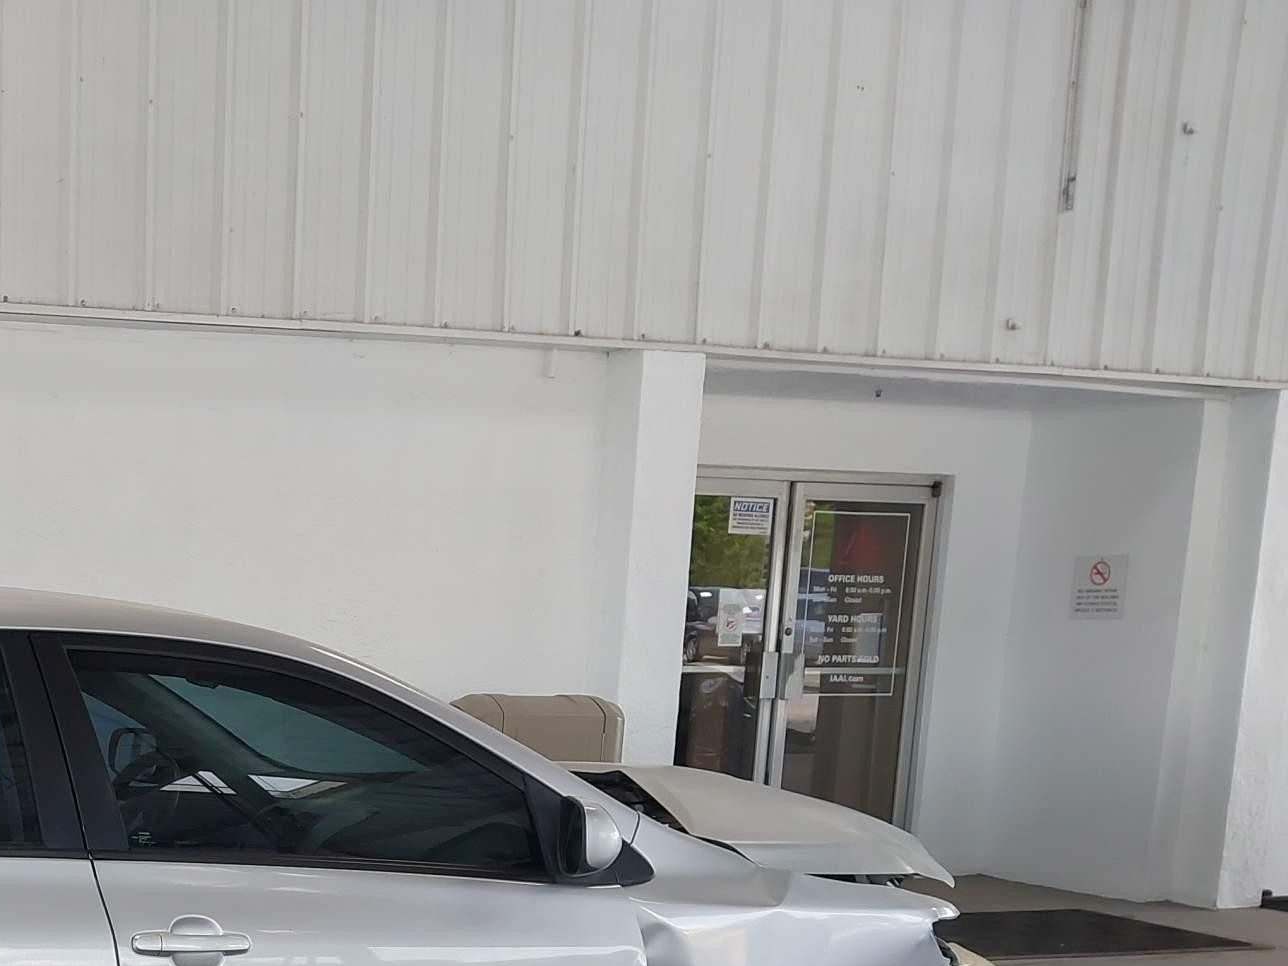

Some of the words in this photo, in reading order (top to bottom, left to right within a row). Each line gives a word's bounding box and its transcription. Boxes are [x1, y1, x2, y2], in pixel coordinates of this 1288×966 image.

[734, 501, 769, 513] NOTICE
[828, 574, 856, 583] OFFICE
[857, 575, 885, 584] HOURS
[827, 614, 849, 623] YARD
[818, 655, 830, 664] NO
[831, 655, 857, 664] PARTS
